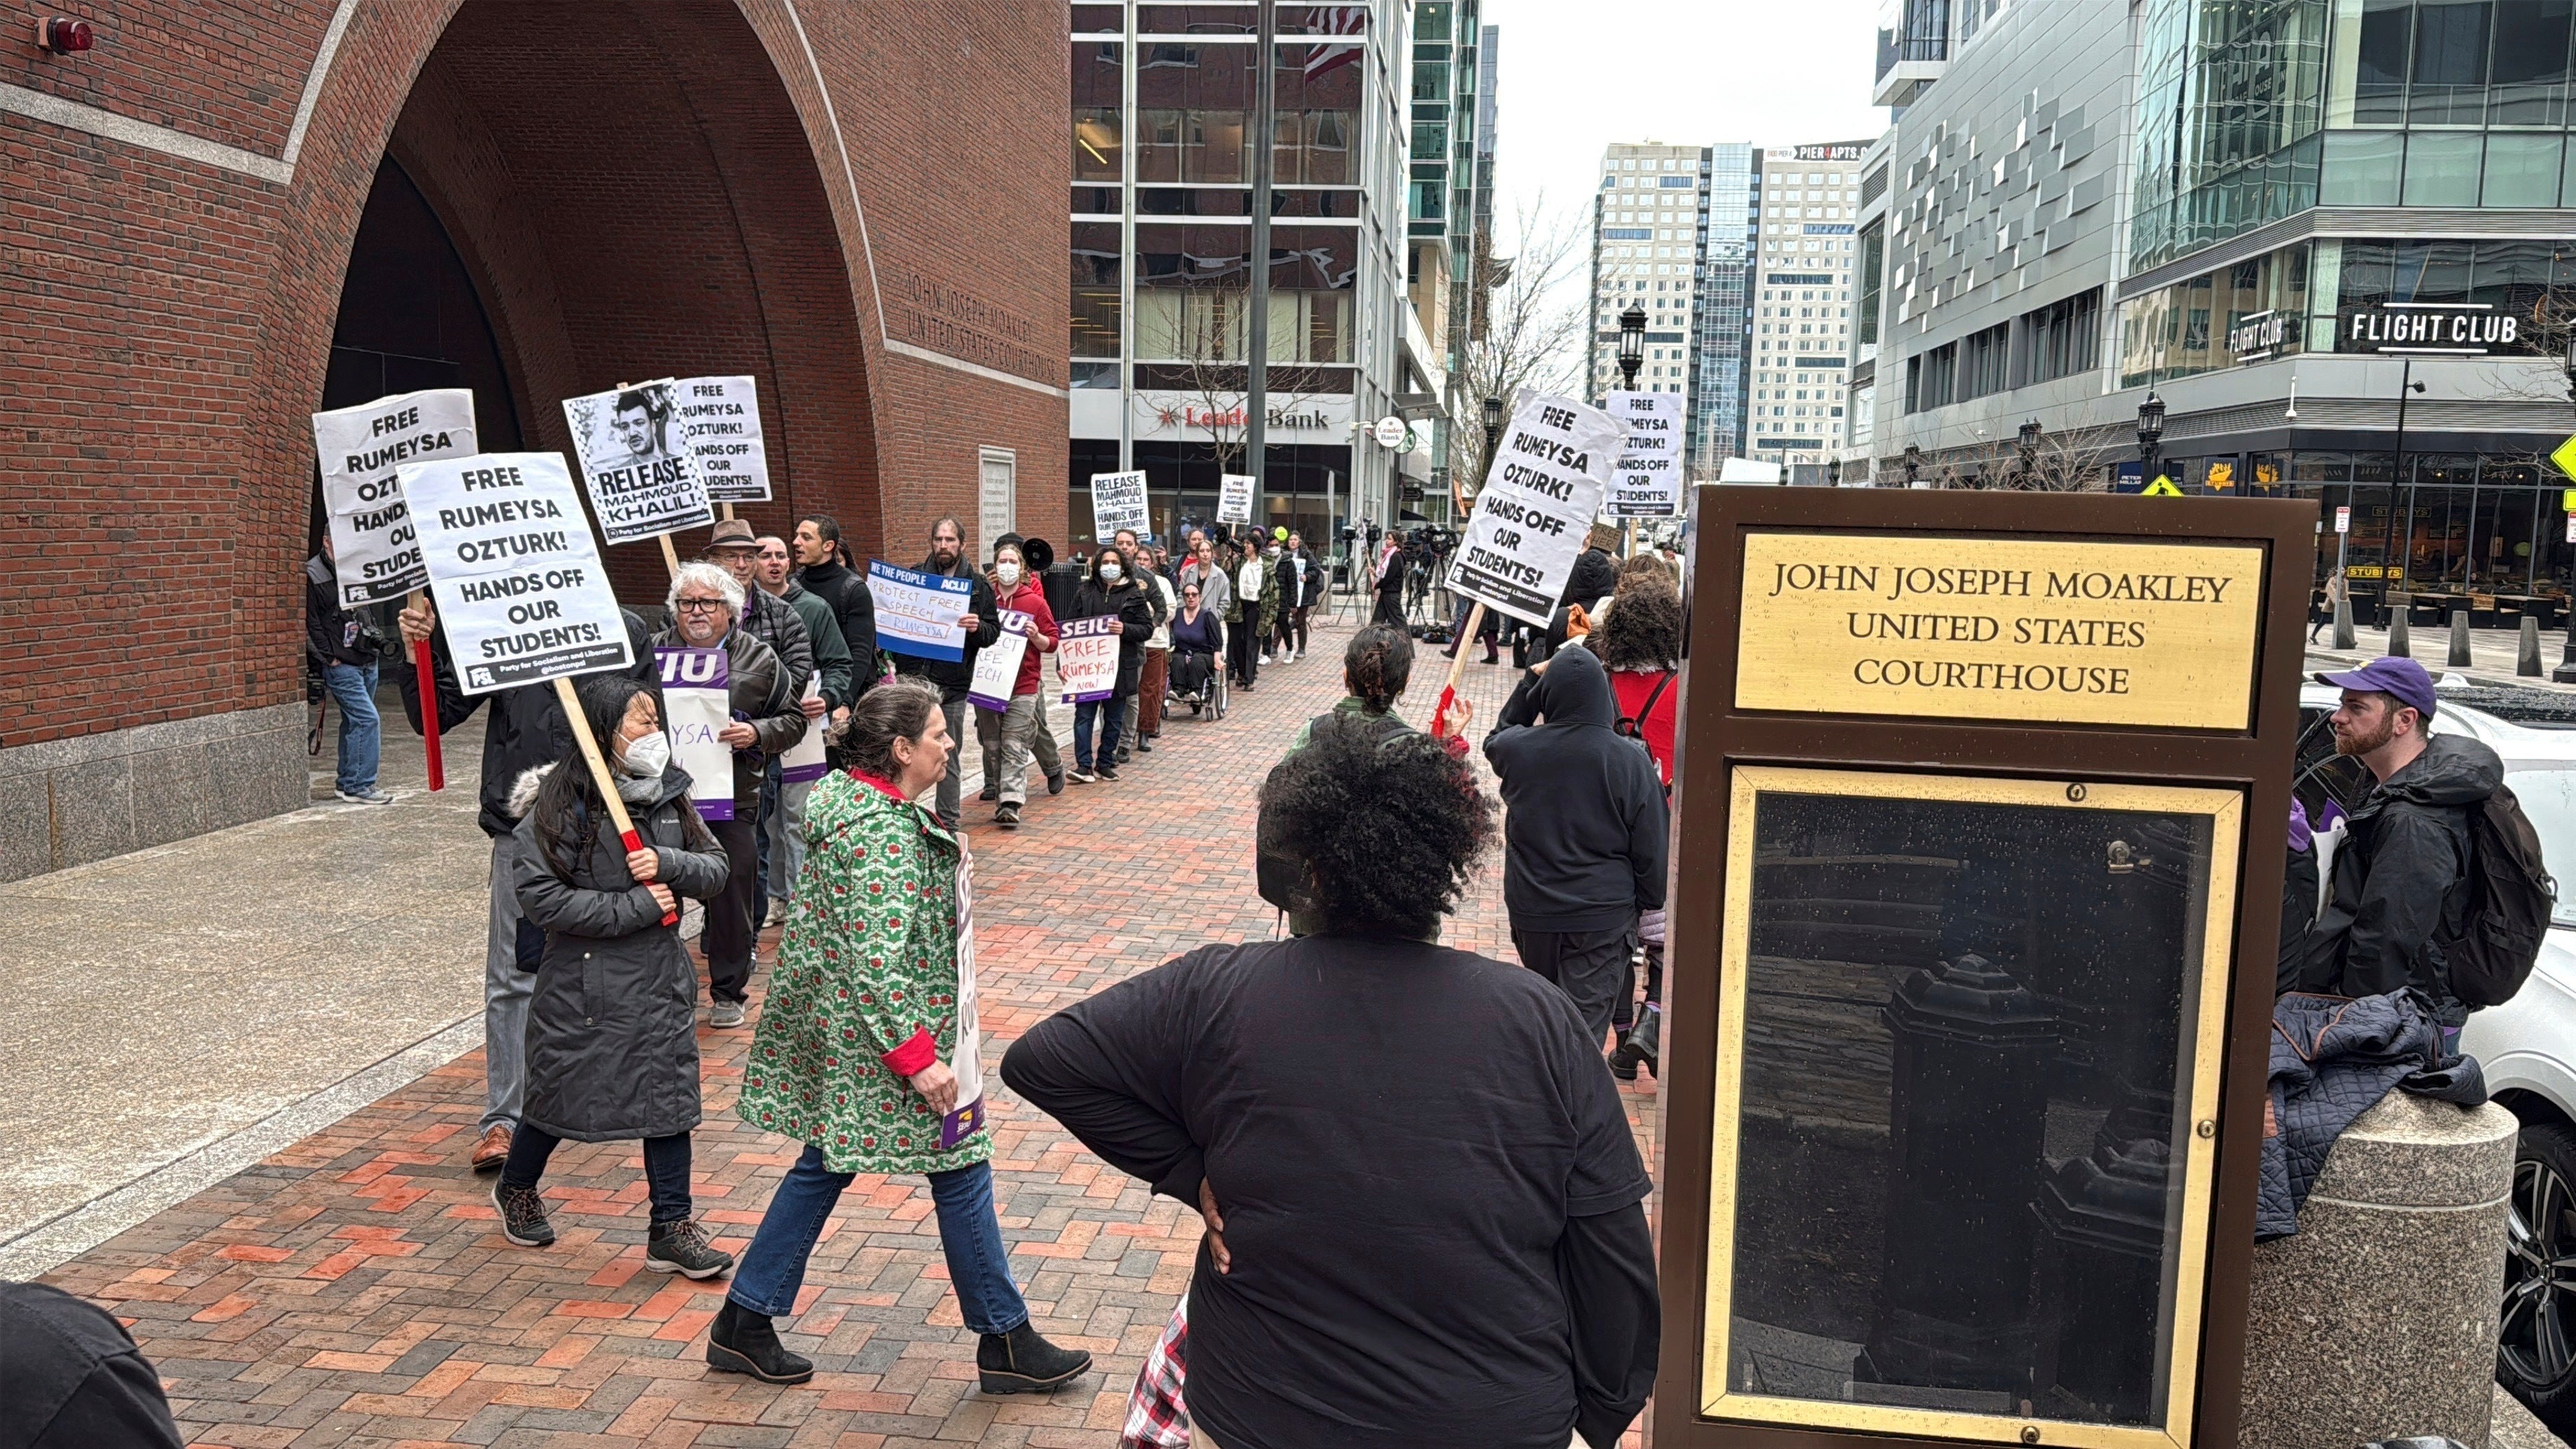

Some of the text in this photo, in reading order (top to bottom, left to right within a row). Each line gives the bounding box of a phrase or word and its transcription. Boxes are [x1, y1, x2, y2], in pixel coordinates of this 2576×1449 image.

[907, 272, 1032, 344] JOHN JOSEPH MOAKLEY
[2229, 317, 2282, 353] FLIGHT CLUB
[2352, 314, 2518, 343] FLIGHT CLUB
[908, 309, 1055, 381] UNITED STATES COURTHOUSE
[693, 384, 724, 398] FREE
[682, 403, 744, 418] RUMEYSA
[1630, 398, 1654, 411] FREE
[372, 406, 420, 438] FREE
[687, 422, 743, 436] OZTURK!
[1266, 409, 1329, 427] Bank
[1540, 405, 1576, 432] FREE
[1625, 417, 1669, 431] MEYSA
[346, 431, 452, 473] RUMEYSA
[695, 444, 749, 456] ANDS OFF
[1512, 431, 1589, 474] RUMEYSA
[1624, 437, 1665, 450] ZTURK!
[598, 457, 689, 497] RELEASE
[706, 460, 732, 471] OUR
[1648, 459, 1670, 471] OFF
[461, 466, 524, 492] FREE
[703, 475, 753, 486] UDENTS!
[1095, 475, 1141, 491] RELEASE
[1503, 463, 1574, 503] OZTURK!
[1627, 475, 1650, 486] OUR
[604, 482, 692, 508] MAHMOUD
[1096, 487, 1142, 501] MAHMOUD
[1616, 490, 1668, 501] STUDENTS!
[353, 502, 411, 532] HAND
[438, 499, 563, 530] RUMEYSA
[608, 493, 697, 523] KHALIL!
[1097, 508, 1144, 523] HANDS OFF
[1485, 496, 1566, 537] HANDS OFF
[390, 523, 416, 546] OU
[1099, 519, 1146, 531] OUR STUDENTS!
[1594, 526, 1621, 541] FREE
[457, 530, 569, 562] OZTURK!
[1494, 527, 1522, 551] OUR
[1590, 535, 1614, 550] HER
[362, 546, 422, 578] STUDE
[1467, 546, 1544, 588] STUDENTS!
[2349, 568, 2401, 577] STUBYS
[377, 581, 395, 590] Party
[460, 569, 585, 602] HANDS OFF
[871, 562, 969, 593] WE THE PEOPLE ACLU
[1768, 563, 2233, 604] JOHN JOSEPH MOAKLEY
[349, 589, 371, 601] PSL
[873, 581, 962, 612] PROTECT FREE
[508, 599, 563, 625] OUR
[889, 600, 934, 621] SPEECH
[1060, 616, 1114, 638] SEIU
[1846, 612, 2146, 649] UNITED STATES
[480, 622, 603, 659] STUDENTS!
[1062, 638, 1111, 659] FREE
[499, 647, 618, 673] Party for Socialism and Liberation
[541, 659, 586, 675] @bostonpsl
[655, 653, 718, 682] IU
[975, 666, 1002, 682] ECH
[1853, 659, 2130, 695] COURTHOUSE
[671, 723, 714, 746] YSA
